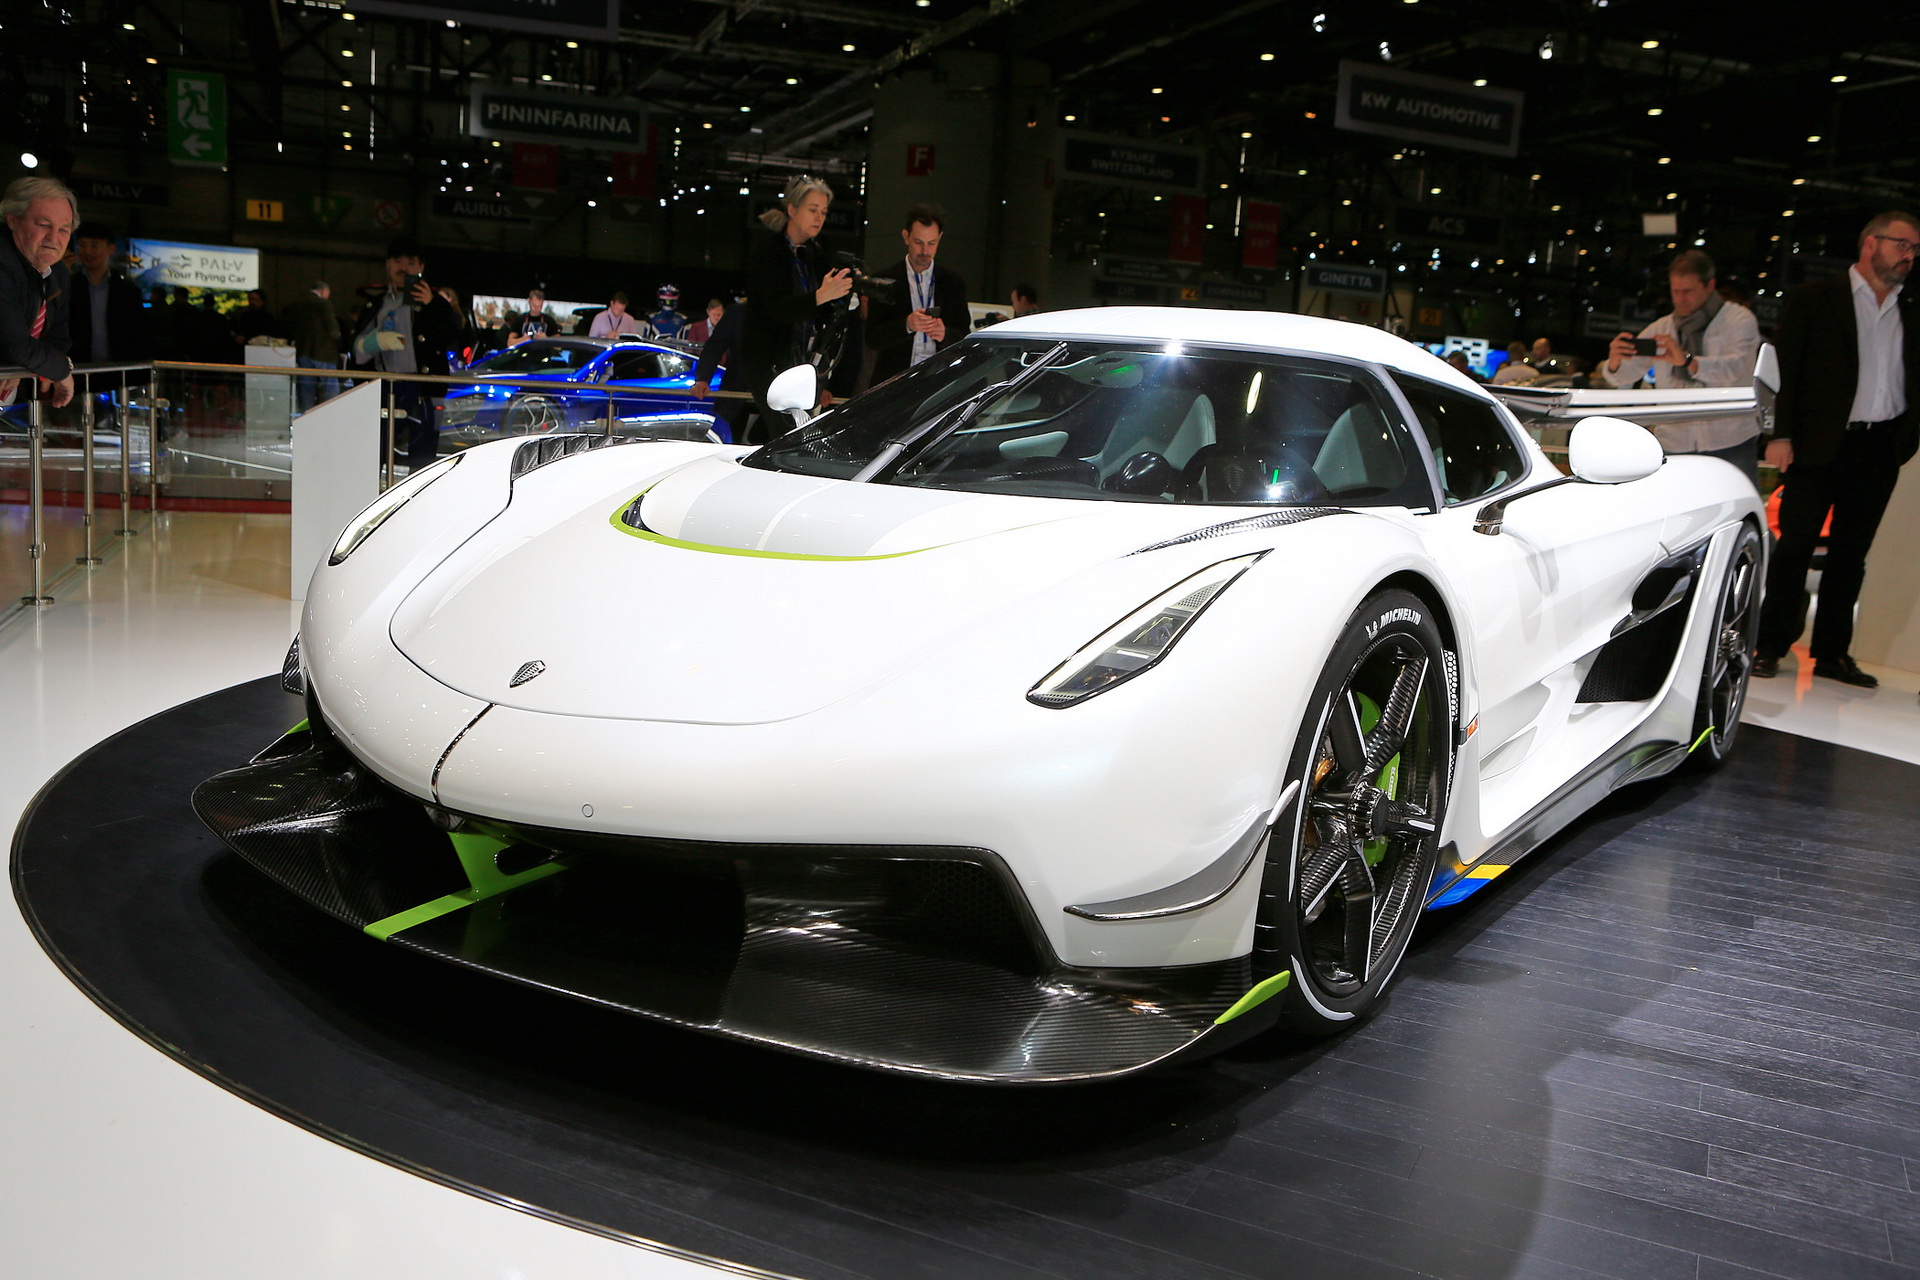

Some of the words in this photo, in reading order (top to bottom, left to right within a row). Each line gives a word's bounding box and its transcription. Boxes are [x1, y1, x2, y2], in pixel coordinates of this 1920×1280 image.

[487, 102, 632, 135] PININFARINA
[1360, 91, 1390, 109] KW
[1395, 97, 1501, 130] AUTOMOTIVE
[914, 147, 929, 168] F
[91, 182, 143, 200] PAL-V
[258, 203, 271, 218] 11
[453, 201, 512, 217] AURUS
[1427, 215, 1467, 236] ACS
[200, 257, 243, 271] PAL-V
[168, 269, 192, 279] Your
[195, 271, 226, 283] Flying
[228, 274, 246, 283] Car
[1319, 271, 1373, 289] GINETTA
[1380, 607, 1421, 629] MICHELIN
